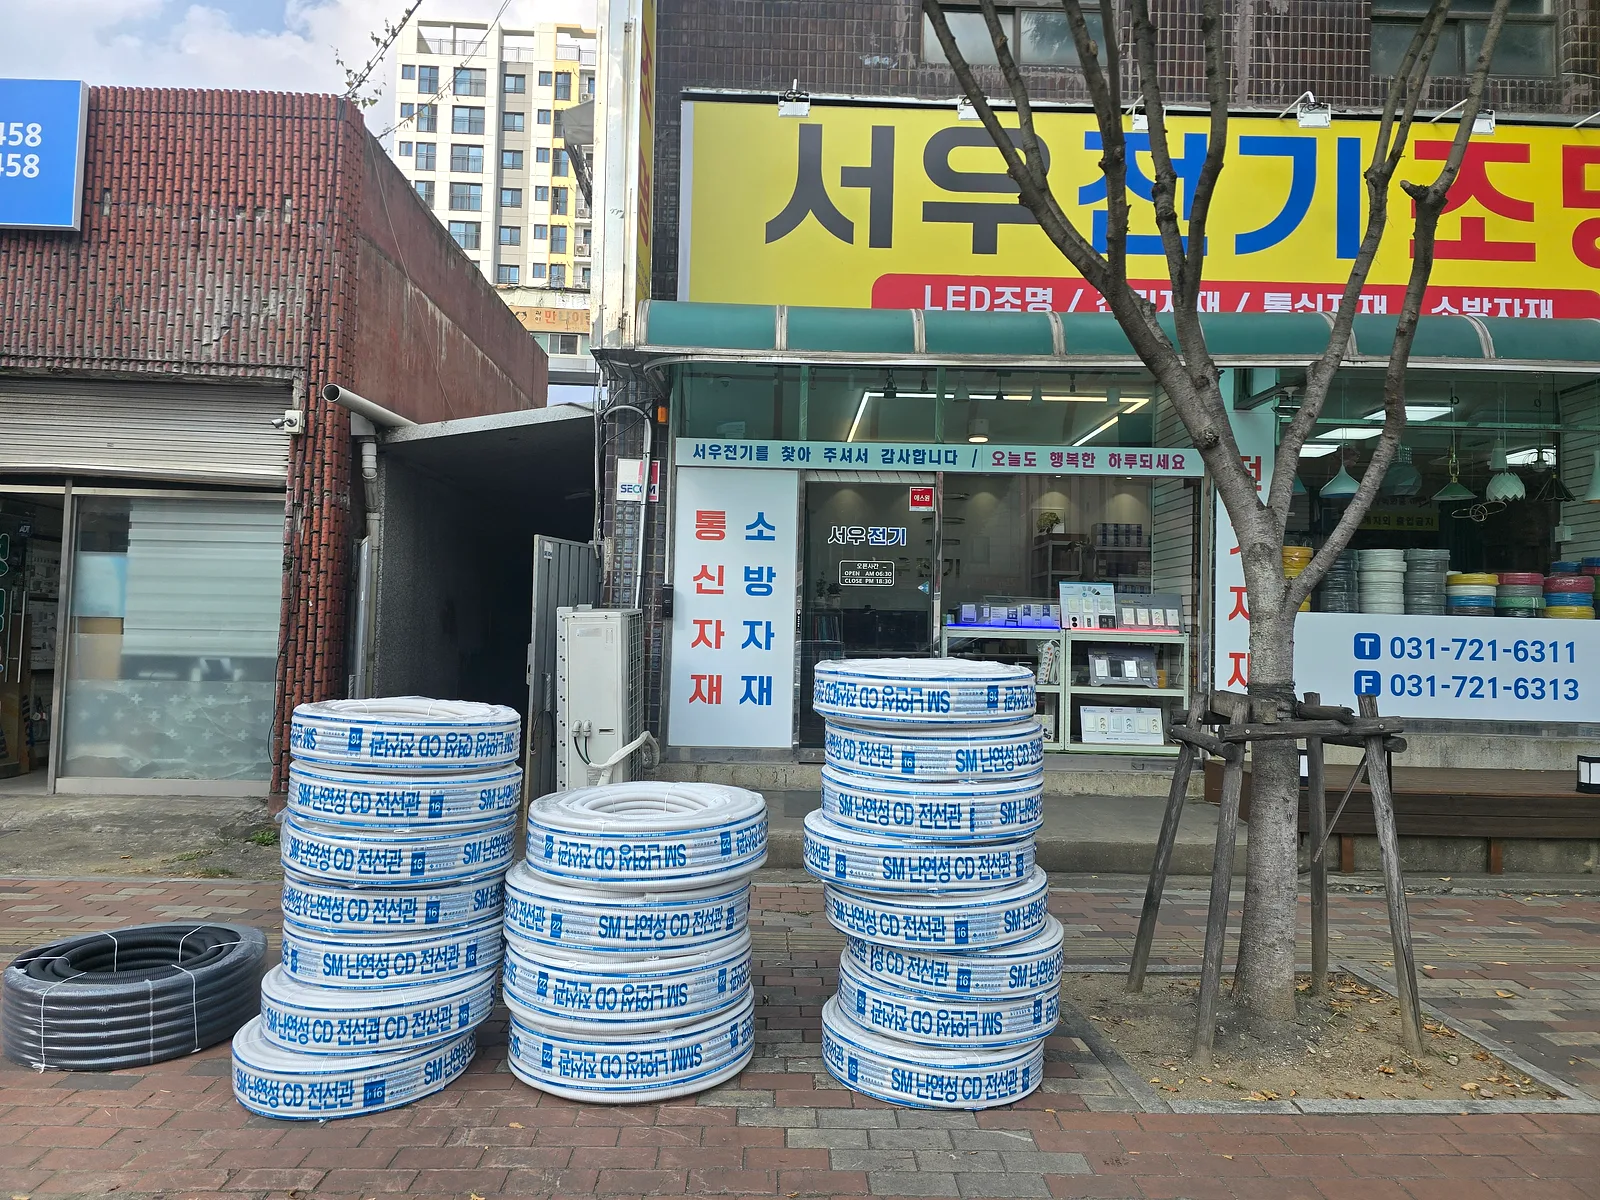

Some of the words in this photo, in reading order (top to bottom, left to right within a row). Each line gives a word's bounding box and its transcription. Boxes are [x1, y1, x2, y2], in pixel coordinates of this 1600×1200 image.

[925, 284, 1053, 312] LED조명
[693, 443, 769, 461] 서우전기를
[781, 446, 811, 462] 찾아
[823, 447, 868, 464] 주셔서
[881, 448, 958, 465] 감사합니다
[991, 450, 1037, 467] 오늘도
[1049, 452, 1095, 469] 행복한
[1108, 453, 1185, 470] 하루되세요
[828, 525, 907, 546] 서우전기
[1390, 636, 1576, 664] 031-721-6311
[859, 688, 878, 709] CD
[882, 686, 924, 713] 난연성
[1390, 674, 1579, 701] 031-721-6313
[928, 690, 950, 713] SM
[369, 732, 415, 758] 전선관
[419, 735, 441, 757] CD
[858, 741, 893, 768] 전선관
[956, 749, 977, 772] SM
[980, 743, 1014, 772] 난연성
[298, 783, 310, 805] SM
[312, 785, 346, 813] 난연성
[351, 791, 371, 813] CD
[375, 791, 421, 816] 전선관
[431, 802, 441, 812] 16
[478, 789, 496, 810] SM
[839, 793, 852, 816] SM
[855, 795, 890, 825] 난연성
[893, 802, 914, 824] CD
[918, 803, 962, 829] 전선관
[1000, 802, 1017, 824] SM
[301, 839, 330, 871] 난연성
[334, 848, 353, 870] CD
[357, 848, 403, 874] 전선관
[413, 859, 423, 869] 16
[463, 843, 481, 864] SM
[558, 841, 591, 867] 전선관
[595, 848, 615, 870] CD
[619, 844, 661, 871] 난연성
[665, 844, 686, 867] SM
[837, 861, 844, 870] 16
[883, 856, 904, 879] SM
[908, 856, 951, 883] 난연성
[954, 857, 974, 879] CD
[978, 851, 1011, 880] 전선관
[348, 899, 368, 921] CD
[372, 897, 418, 924] 전선관
[427, 909, 436, 918] 16
[474, 889, 488, 911] SM
[552, 920, 561, 930] 22
[599, 914, 620, 939] SM
[624, 911, 668, 941] 난연성
[670, 914, 689, 936] CD
[693, 906, 723, 936] 전선관
[845, 906, 877, 936] 난연성
[880, 913, 899, 936] CD
[903, 915, 946, 942] 전선관
[957, 927, 966, 937] 16
[1004, 911, 1020, 933] SM
[323, 952, 343, 976] SM
[347, 952, 389, 979] 난연성
[394, 953, 416, 975] CD
[420, 943, 461, 974] 전선관
[886, 952, 904, 973] CD
[908, 956, 949, 987] 전선관
[959, 976, 968, 986] 16
[1009, 965, 1027, 988] SM
[553, 978, 592, 1009] 전선관
[595, 987, 618, 1010] CD
[621, 983, 663, 1012] 난연성
[667, 983, 688, 1006] SM
[278, 1015, 309, 1045] 난연성
[313, 1019, 333, 1043] CD
[384, 1016, 408, 1040] CD
[411, 1004, 453, 1038] 전선관
[871, 999, 908, 1032] 전선관
[911, 1010, 933, 1034] CD
[937, 1010, 979, 1038] 난연성
[983, 1012, 1002, 1035] SM
[424, 1058, 442, 1085] SM
[558, 1049, 597, 1079] 전선관
[600, 1055, 622, 1078] CD
[626, 1049, 668, 1080] 난연성
[248, 1074, 279, 1108] 난연성
[282, 1083, 303, 1106] CD
[308, 1080, 355, 1110] 전선관
[892, 1068, 912, 1093] SM
[917, 1073, 958, 1102] 난연성
[962, 1077, 982, 1099] CD
[986, 1068, 1018, 1099] 전선관
